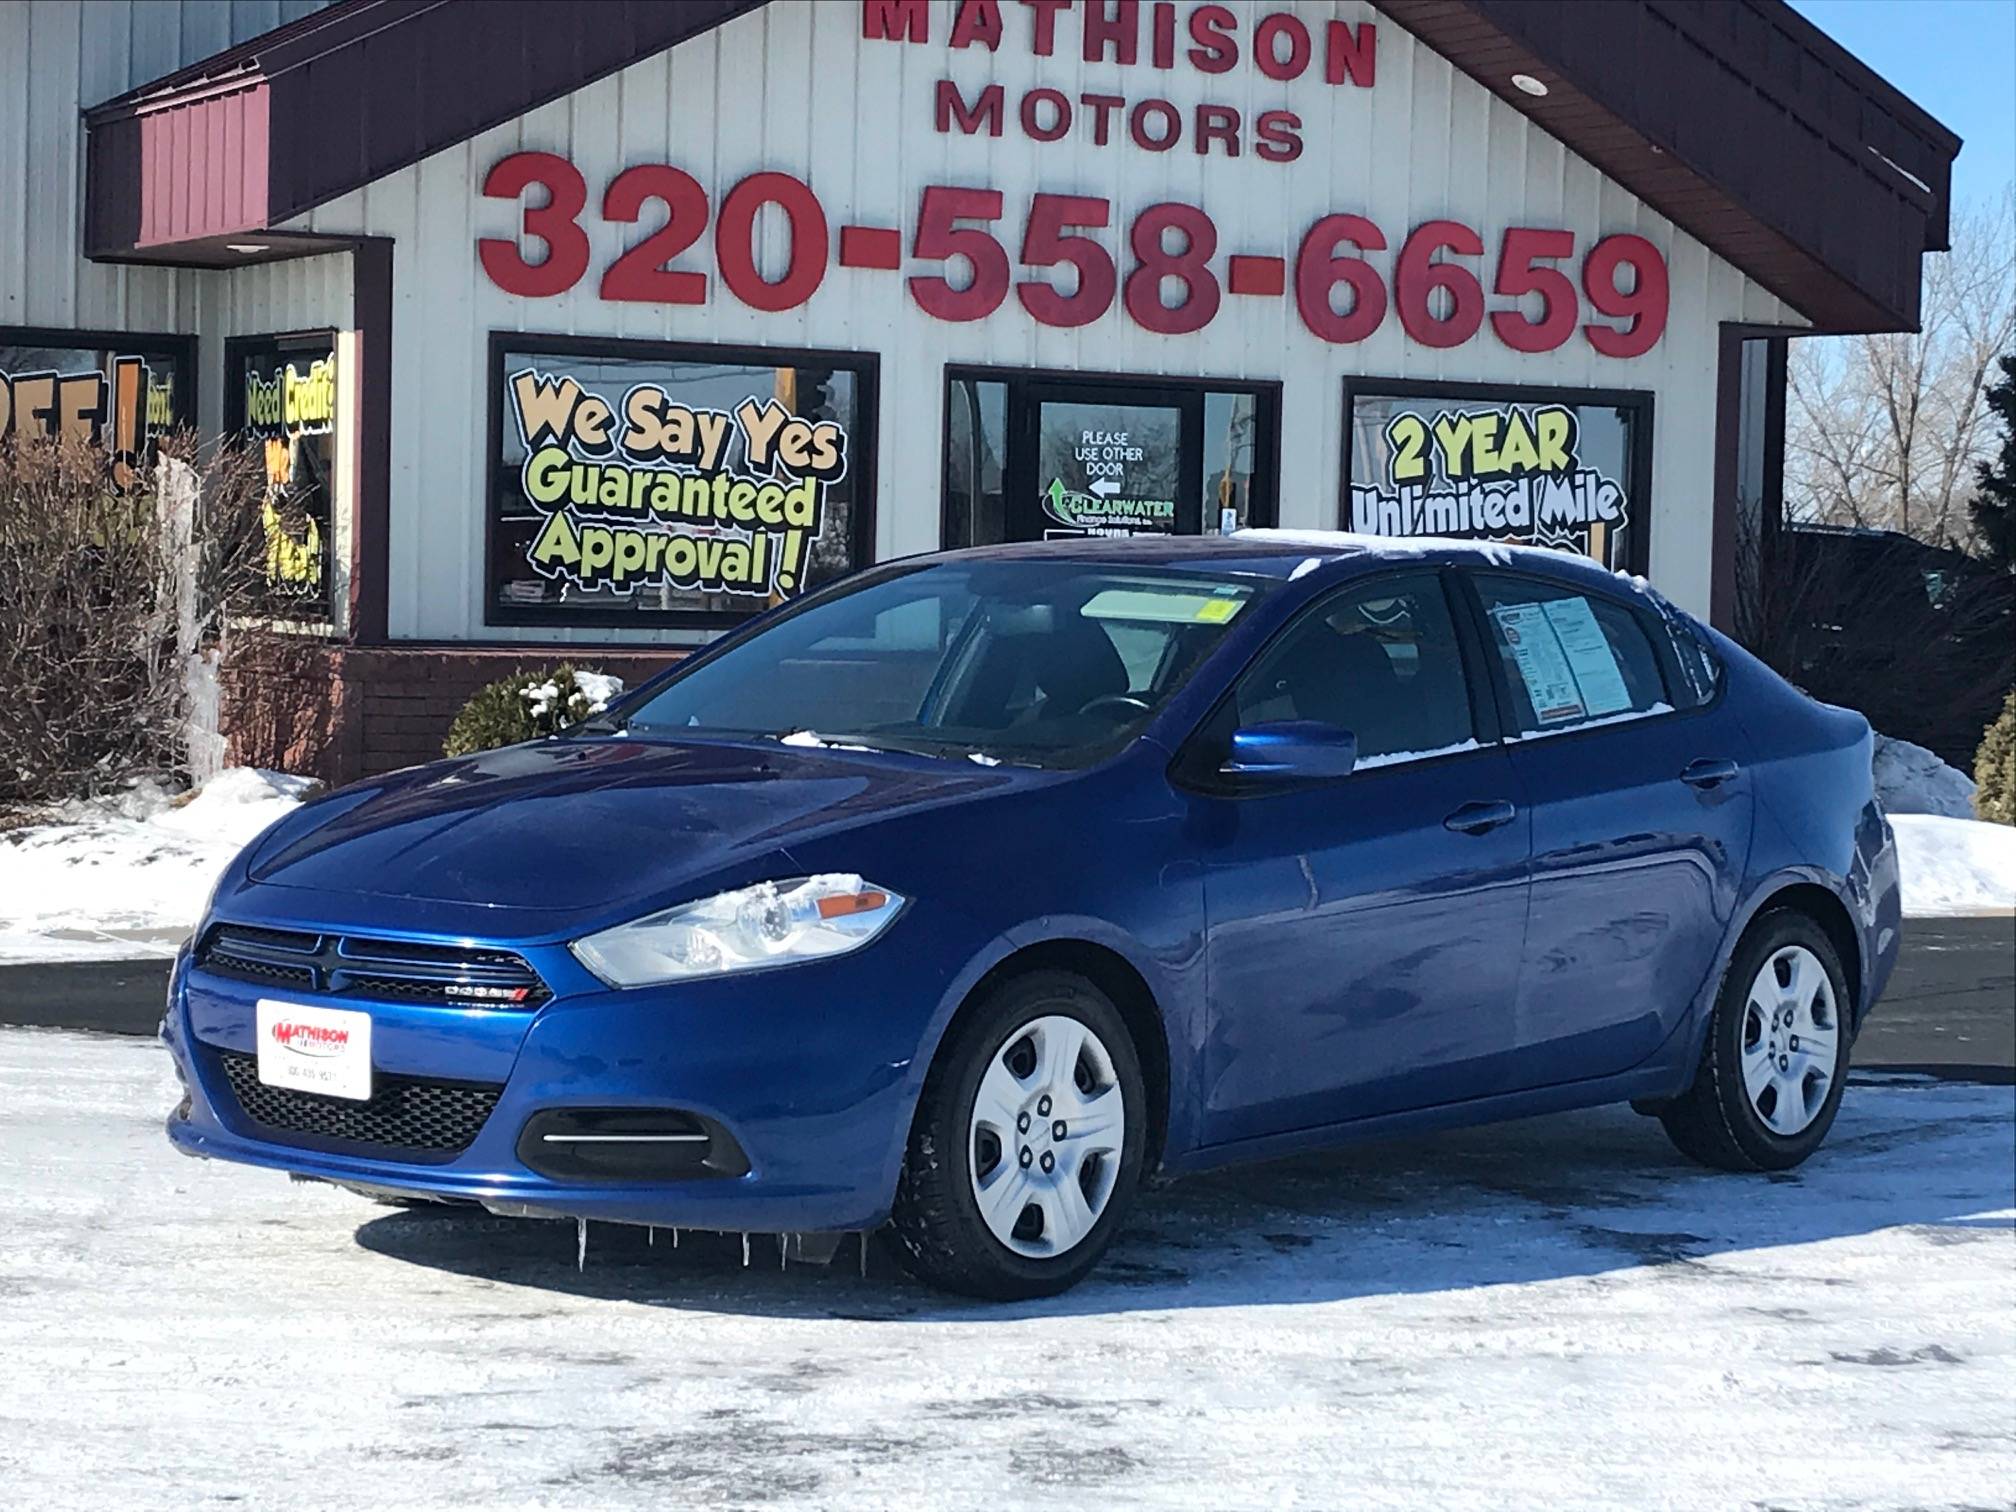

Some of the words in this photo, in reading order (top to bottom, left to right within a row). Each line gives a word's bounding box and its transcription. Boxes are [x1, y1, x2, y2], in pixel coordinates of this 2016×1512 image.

[862, 0, 1377, 88] MATHISON
[935, 80, 1304, 162] MOTORS
[478, 151, 1670, 359] 320-558-6659
[513, 372, 613, 448] We
[623, 388, 729, 471] Say
[736, 400, 840, 471] Yes
[1075, 446, 1100, 461] USE
[1102, 446, 1144, 462] OTHER
[1082, 430, 1129, 445] PLEASE
[1390, 416, 1427, 481] 2
[1434, 406, 1571, 477] YEAR
[526, 446, 819, 529] Guaranteed
[1086, 462, 1125, 476] DOOR
[1071, 496, 1174, 517] CLEARWATER
[1351, 476, 1531, 537] Unlimited
[1540, 472, 1620, 526] Mile
[276, 1022, 349, 1045] MATHISON
